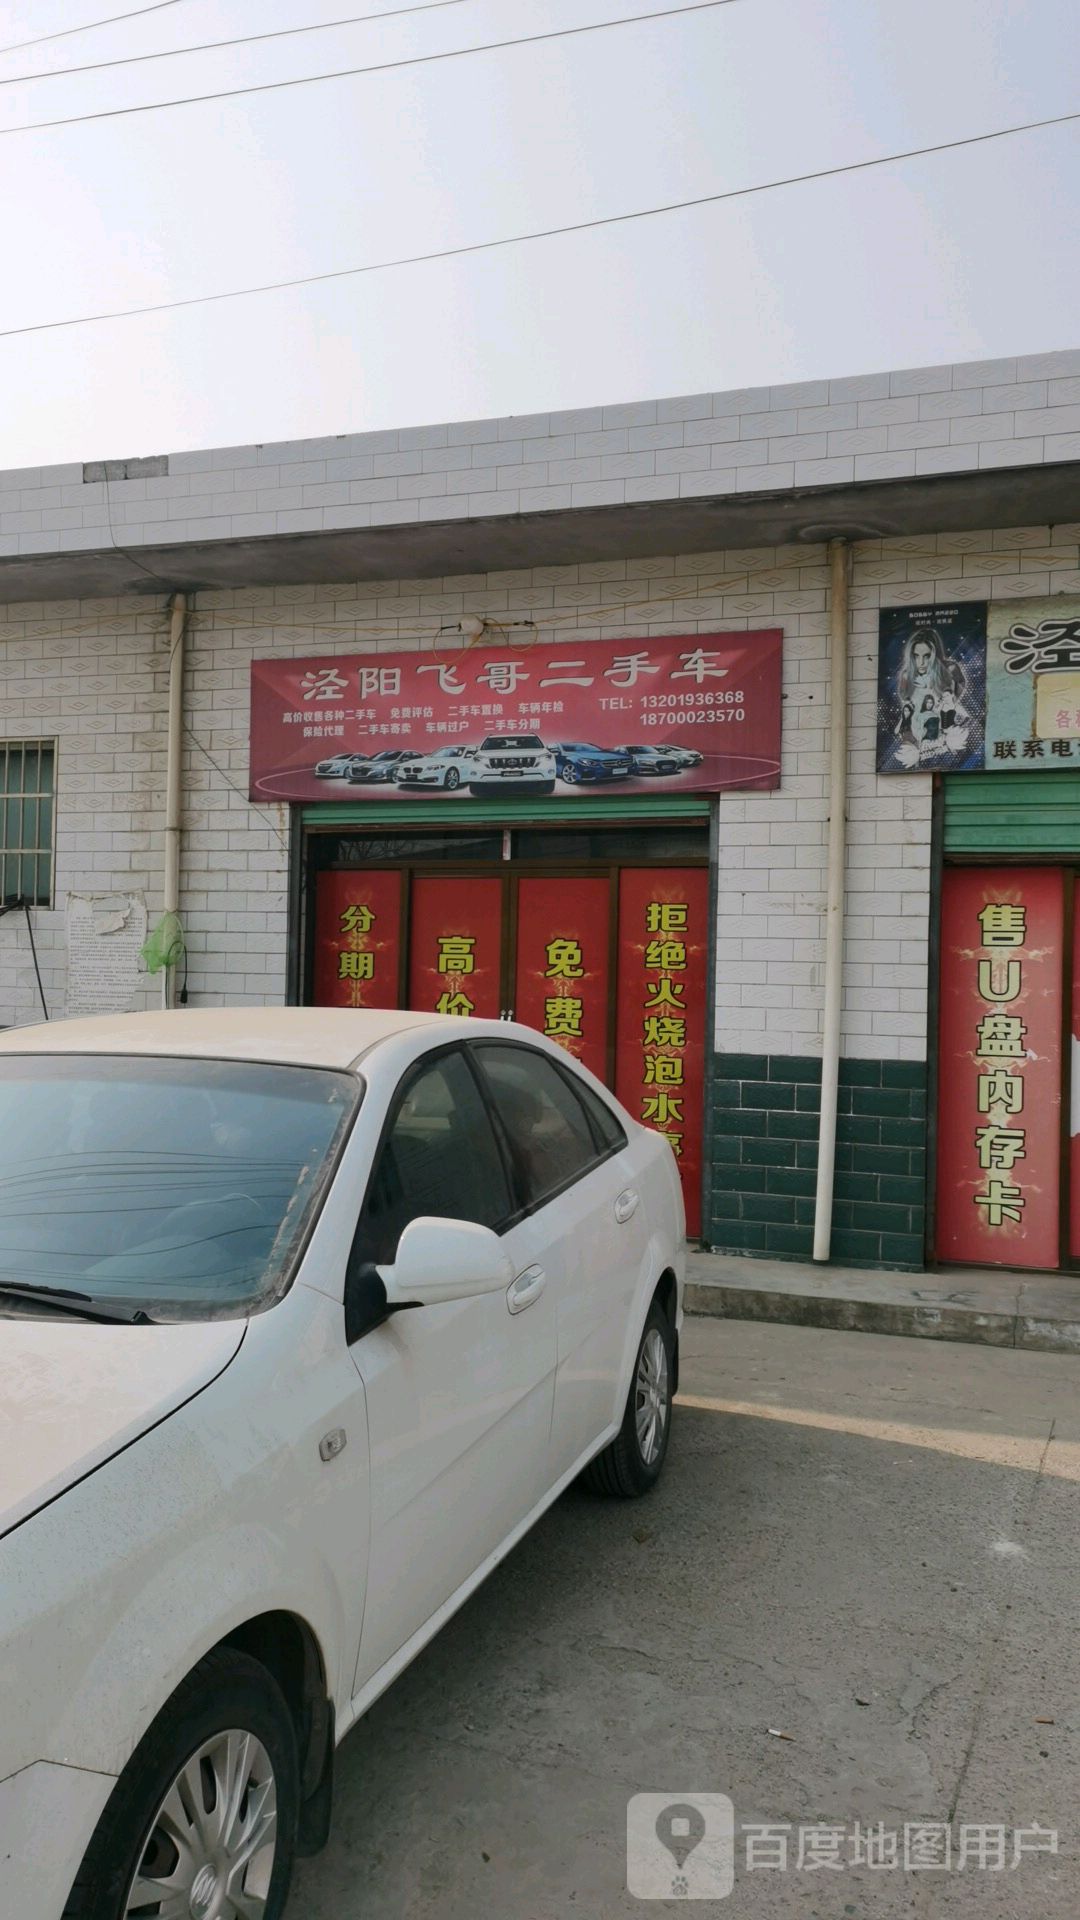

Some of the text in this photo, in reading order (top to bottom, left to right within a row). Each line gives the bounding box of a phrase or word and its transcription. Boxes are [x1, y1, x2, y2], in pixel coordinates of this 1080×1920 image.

[301, 648, 729, 700] 泾阳飞哥二手车
[390, 706, 434, 719] 免费评估
[447, 703, 504, 717] 二手车置换
[518, 700, 564, 714] 车辆年检
[598, 690, 745, 711] TEL: 13201936368
[640, 708, 746, 726] 18700023570
[303, 718, 541, 738] 保险代理 二手车寄卖 车辆过户 二手车分期
[993, 739, 1080, 760] 联系电
[338, 904, 376, 980] 分期
[543, 937, 584, 1037] 免费
[973, 903, 1028, 1226] 售U盘内存卡
